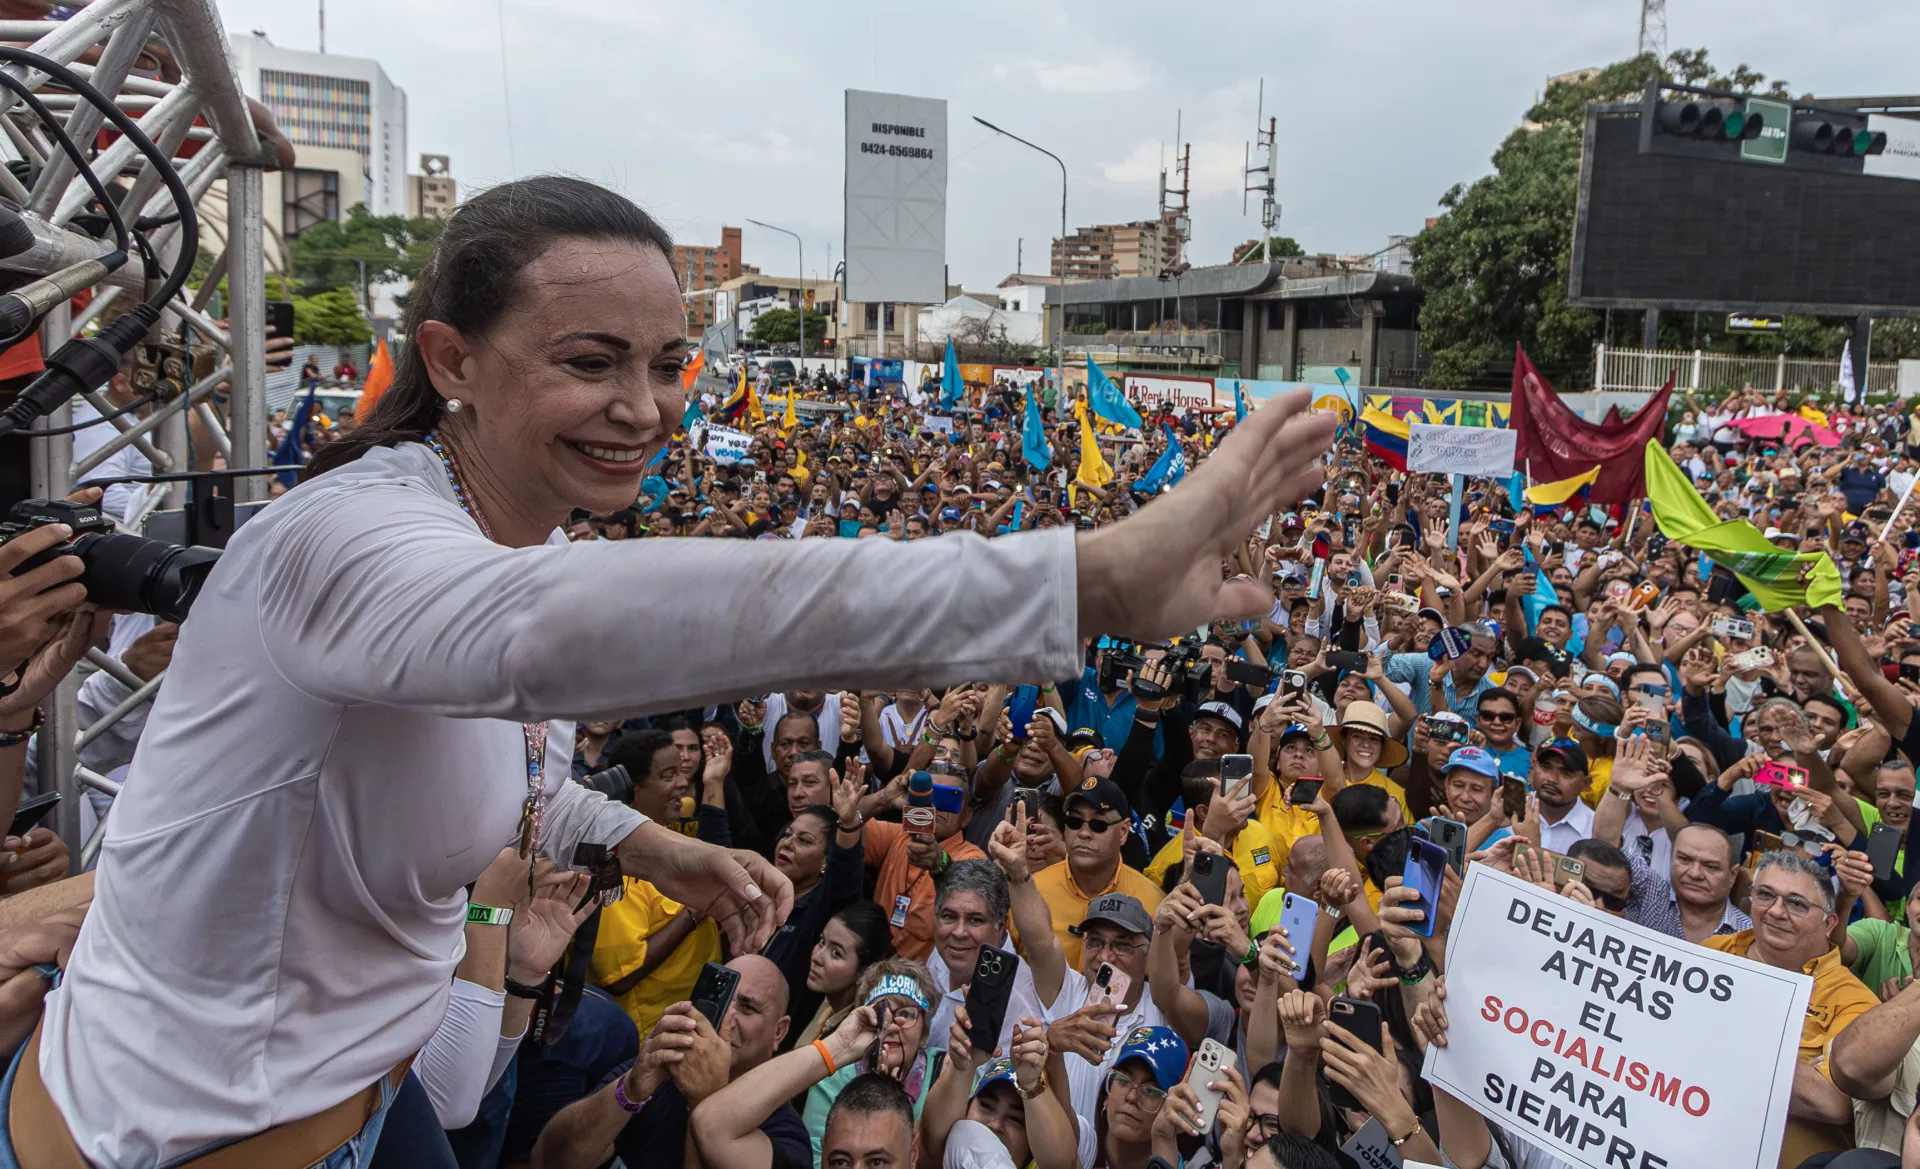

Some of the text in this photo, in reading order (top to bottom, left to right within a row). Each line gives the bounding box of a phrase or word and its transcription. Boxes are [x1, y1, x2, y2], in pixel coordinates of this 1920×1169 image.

[872, 122, 925, 138] DISPONIBLE
[861, 142, 933, 159] 0424-6569864
[1173, 388, 1209, 410] House
[79, 515, 98, 524] SONY
[469, 909, 488, 920] VIP
[1099, 898, 1127, 912] CAT
[1507, 897, 1734, 1002] DEJAREMOS
[1541, 950, 1675, 1021] ATRÁS
[1579, 1001, 1623, 1043] EL
[1480, 995, 1711, 1118] SOCIALISMO
[1530, 1057, 1628, 1129] PARA
